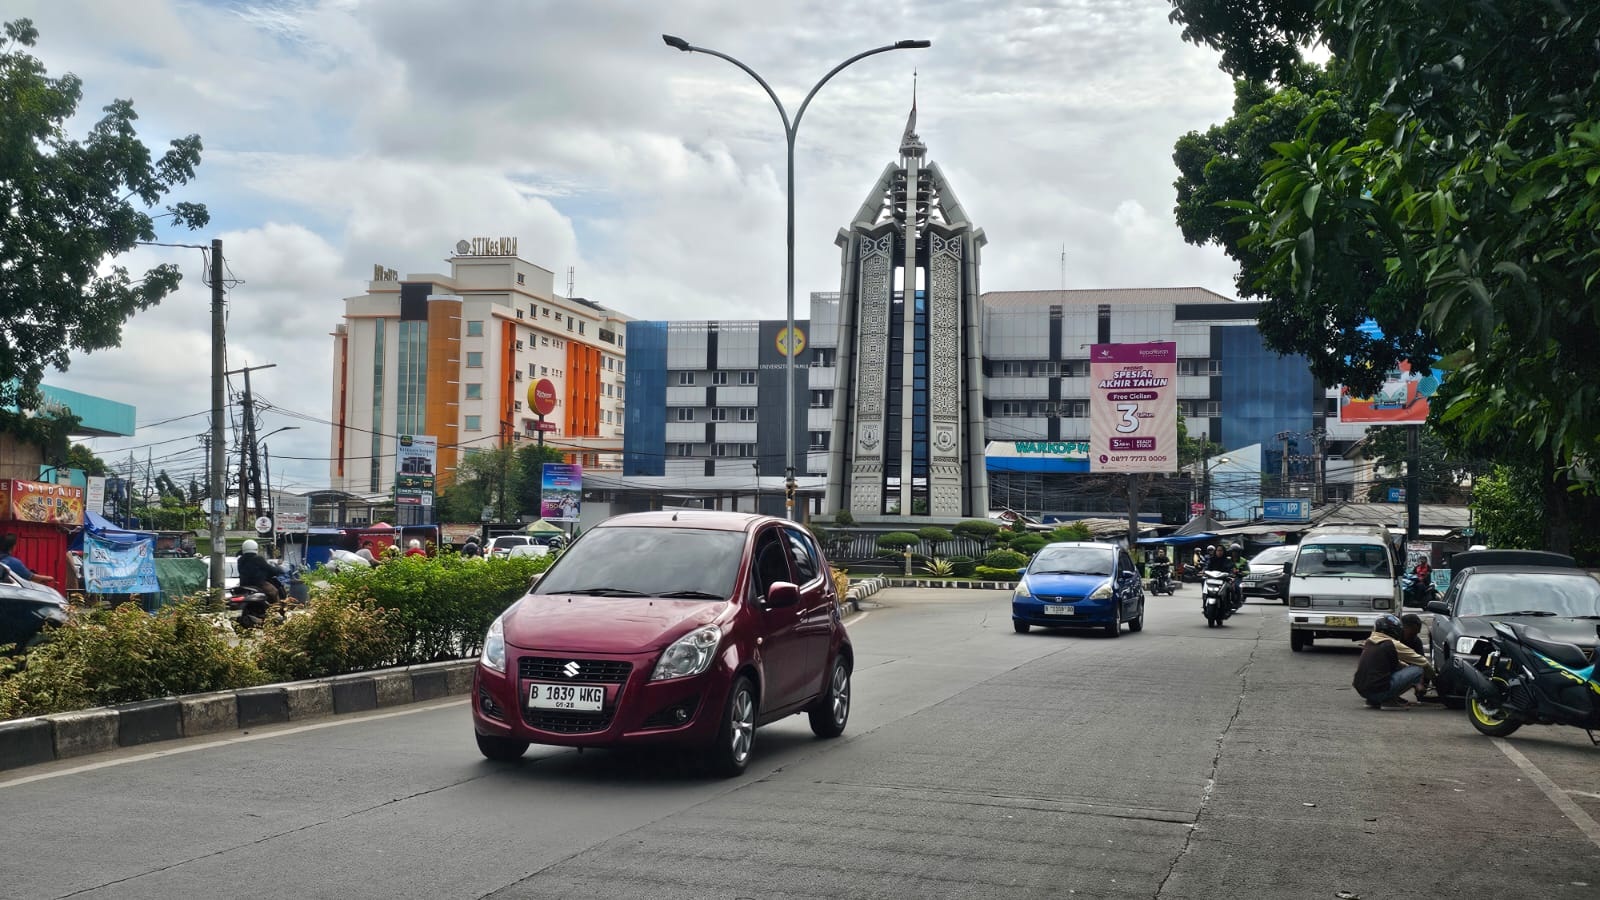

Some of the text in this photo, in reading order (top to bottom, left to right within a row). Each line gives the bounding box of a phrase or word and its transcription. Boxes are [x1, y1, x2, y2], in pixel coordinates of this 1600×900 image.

[1113, 370, 1153, 379] SPESIAL
[1099, 378, 1168, 388] AKHIR TAHUN
[1116, 403, 1140, 433] 3
[1015, 441, 1077, 454] WARKOP
[531, 685, 602, 702] B 1839 WKG
